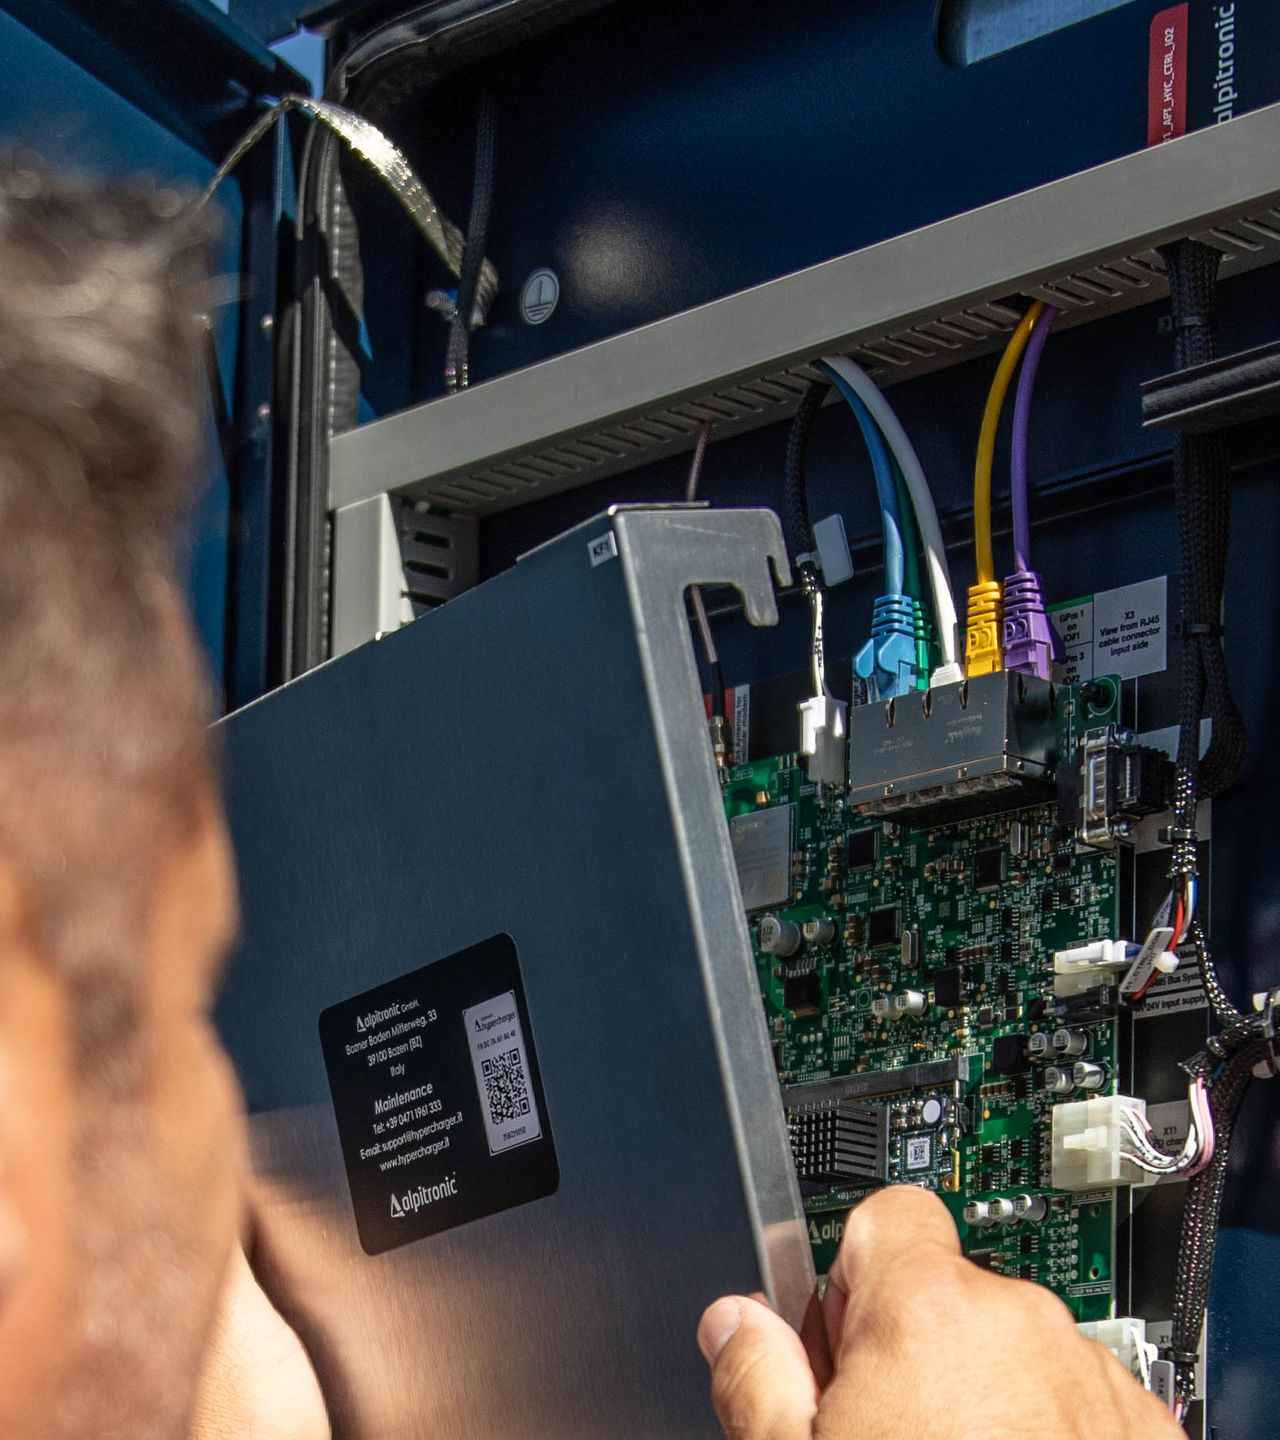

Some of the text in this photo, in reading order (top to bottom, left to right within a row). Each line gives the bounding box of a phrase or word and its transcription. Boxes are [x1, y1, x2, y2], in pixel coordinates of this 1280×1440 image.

[1100, 615, 1160, 637] View from RJ45
[1125, 610, 1135, 620] X3
[1066, 624, 1077, 632] on
[1098, 627, 1161, 649] cable connector
[1110, 640, 1149, 657] input side
[1168, 974, 1181, 985] Bus
[364, 1002, 401, 1029] alpitronic
[368, 1030, 391, 1046] Boden
[428, 1009, 438, 1022] 33
[367, 1035, 423, 1067] 39100 Bozen (BZ)
[390, 1062, 405, 1077] Italy
[374, 1083, 433, 1115] Maintenance
[385, 1117, 398, 1129] +39
[429, 1099, 443, 1114] 333
[379, 1136, 450, 1171] www.hypercharger.it
[401, 1176, 458, 1213] alpitronic
